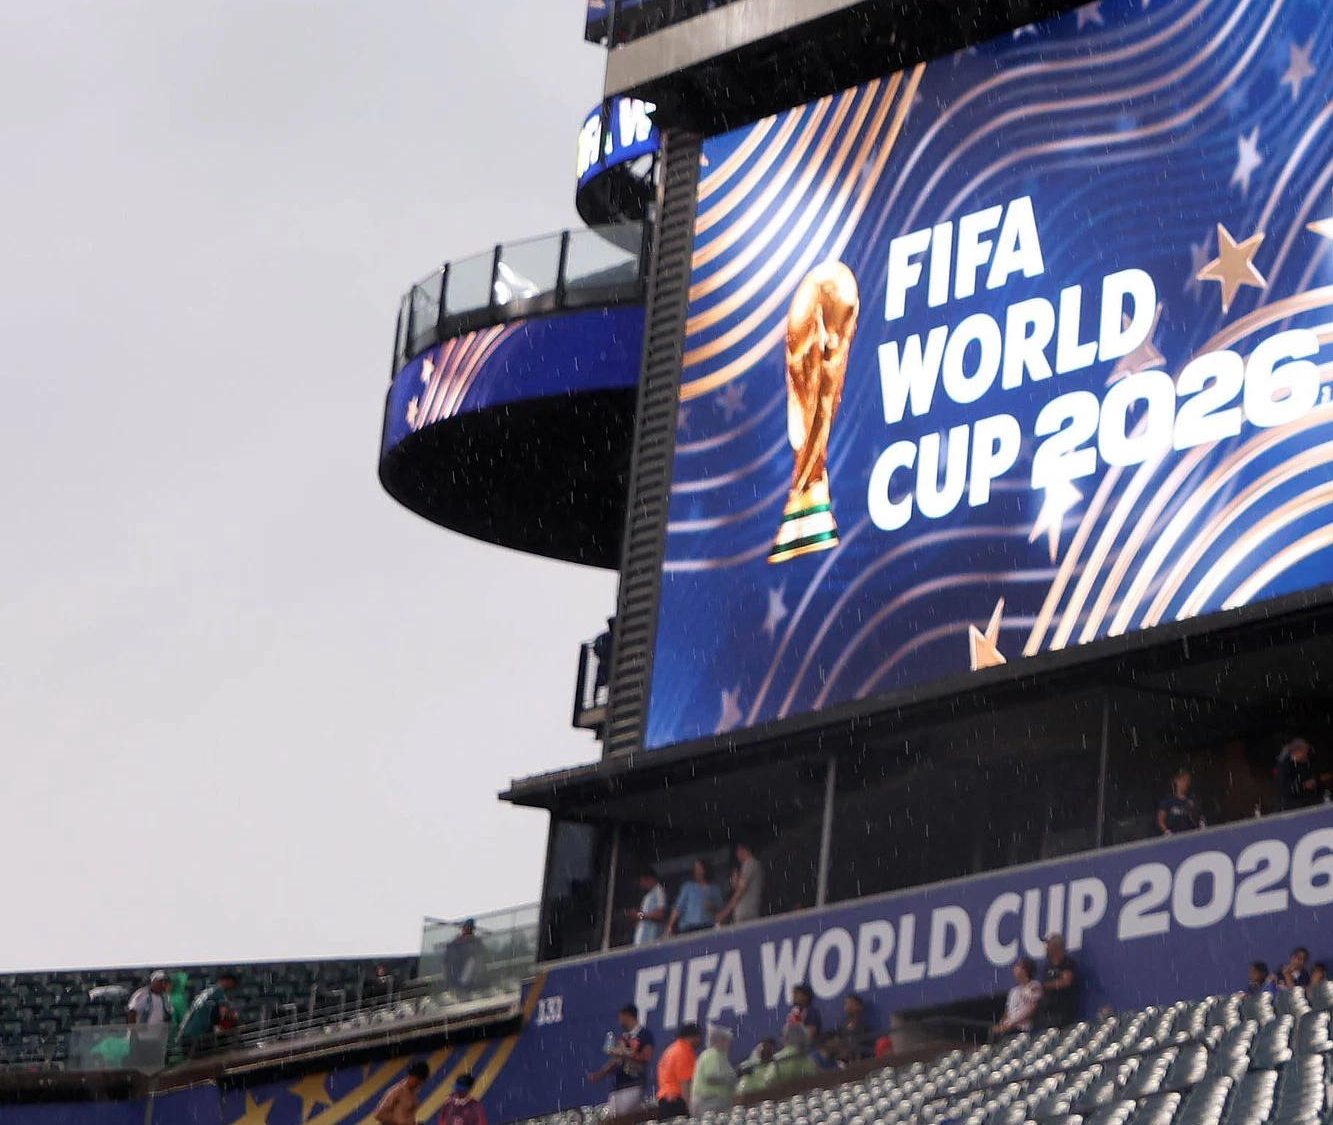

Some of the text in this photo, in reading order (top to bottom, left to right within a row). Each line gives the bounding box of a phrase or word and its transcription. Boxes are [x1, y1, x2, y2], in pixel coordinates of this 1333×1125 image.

[884, 195, 1045, 321] FIFA
[878, 268, 1157, 424] WORLD
[867, 328, 1322, 531] CUP 2026
[634, 949, 748, 1030] FIFA
[761, 905, 971, 1010] WORLD
[981, 877, 1108, 966] CUP
